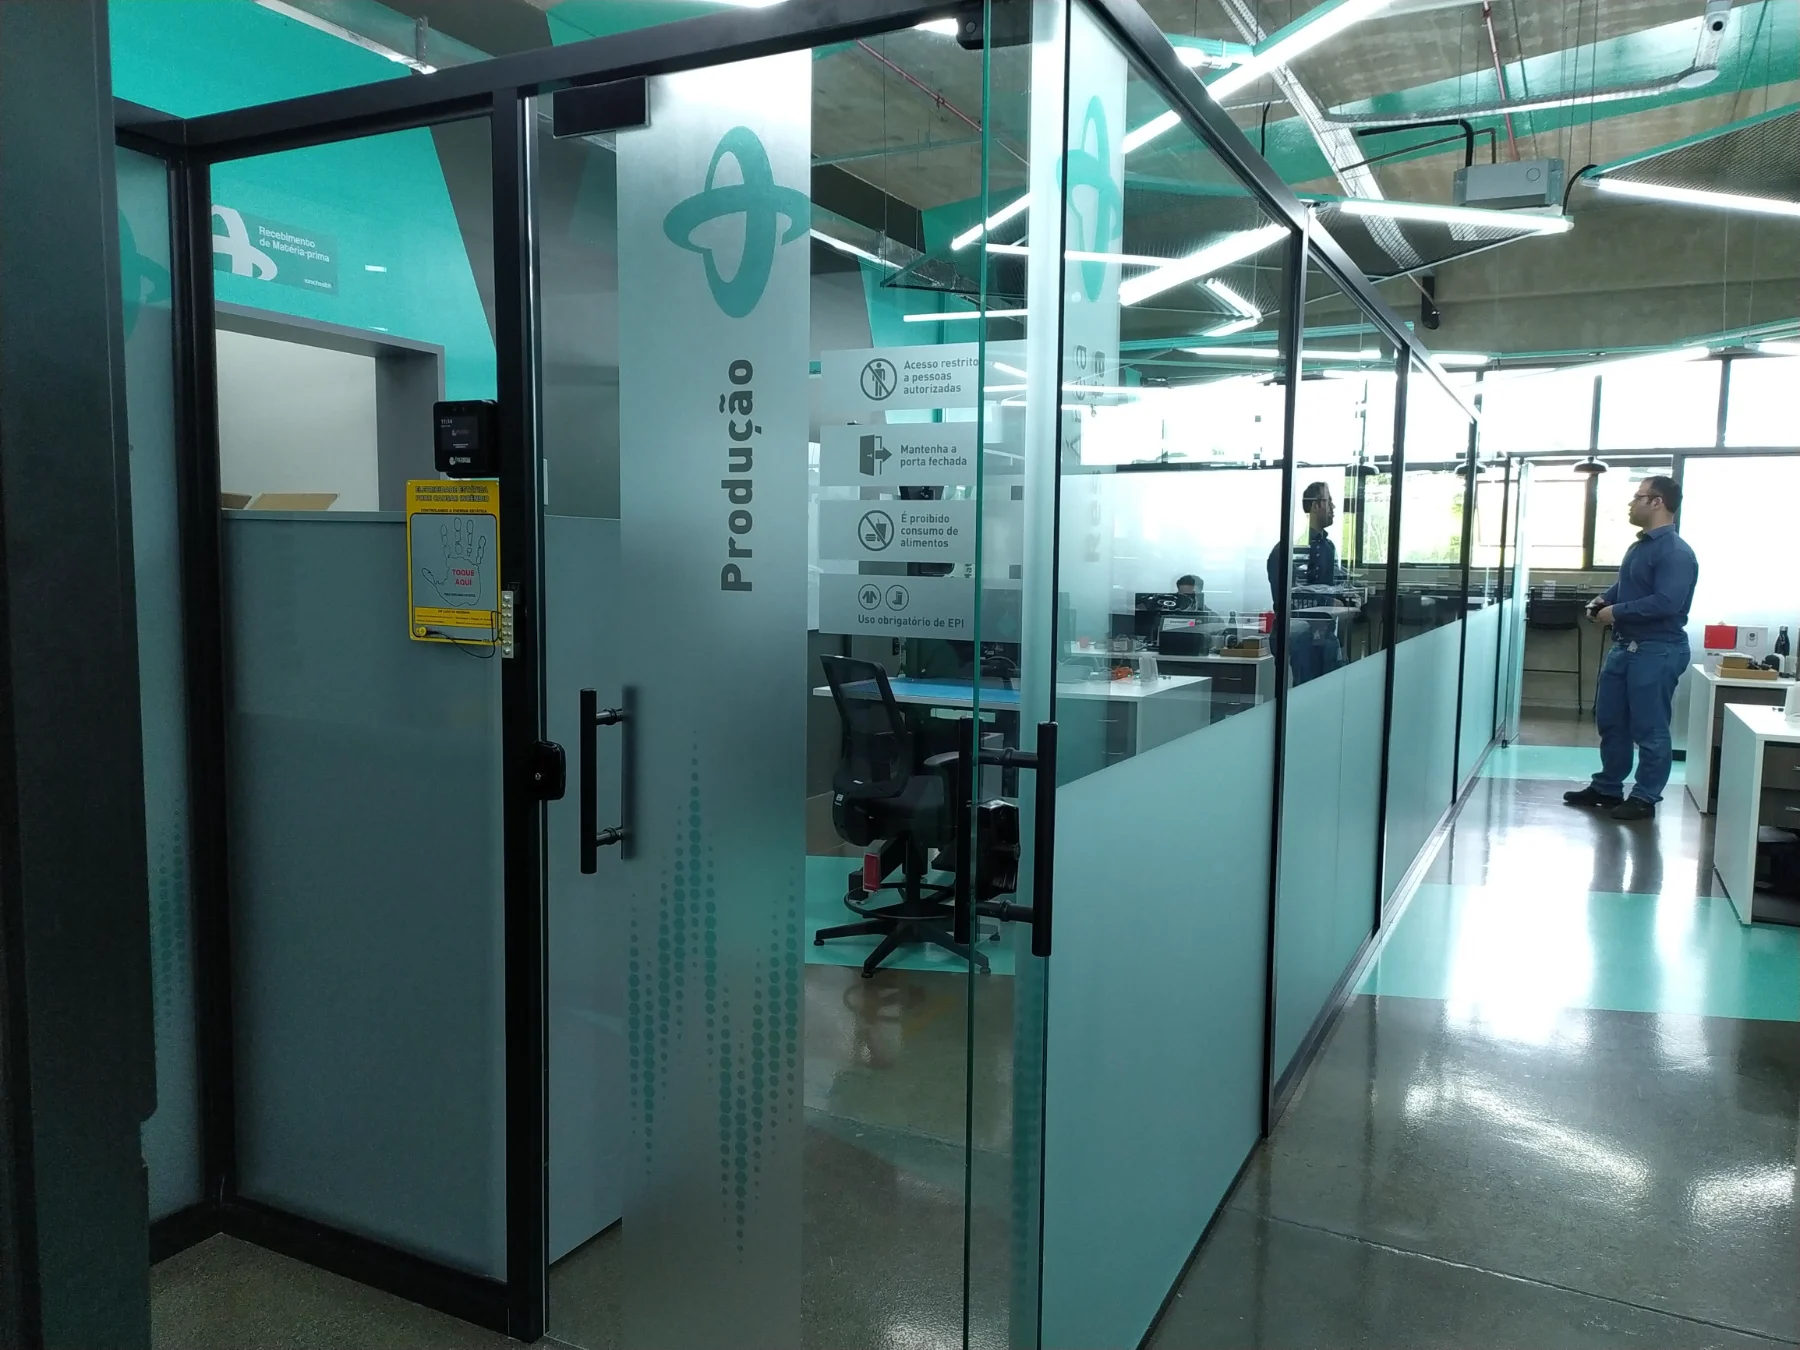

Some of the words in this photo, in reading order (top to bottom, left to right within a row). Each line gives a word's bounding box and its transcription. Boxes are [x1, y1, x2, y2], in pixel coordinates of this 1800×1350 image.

[259, 226, 315, 248] Recebimento
[259, 237, 271, 248] de
[273, 241, 330, 263] Matéria-prima
[903, 359, 938, 370] Acesso
[941, 356, 979, 368] restrito
[903, 374, 909, 382] a
[912, 372, 952, 384] pessoas
[903, 384, 962, 395] autorizadas
[900, 443, 949, 454] Mantenha
[951, 445, 957, 454] a
[900, 456, 926, 468] porta
[928, 456, 967, 466] fechada
[719, 359, 762, 592] Produção
[901, 510, 907, 523] É
[909, 513, 950, 525] proibido
[900, 527, 944, 536] consumo
[946, 526, 959, 536] de
[900, 538, 949, 548] alimentos
[858, 614, 876, 624] Uso
[877, 614, 930, 627] obrigatório
[933, 617, 946, 627] de
[948, 618, 965, 629] EPI
